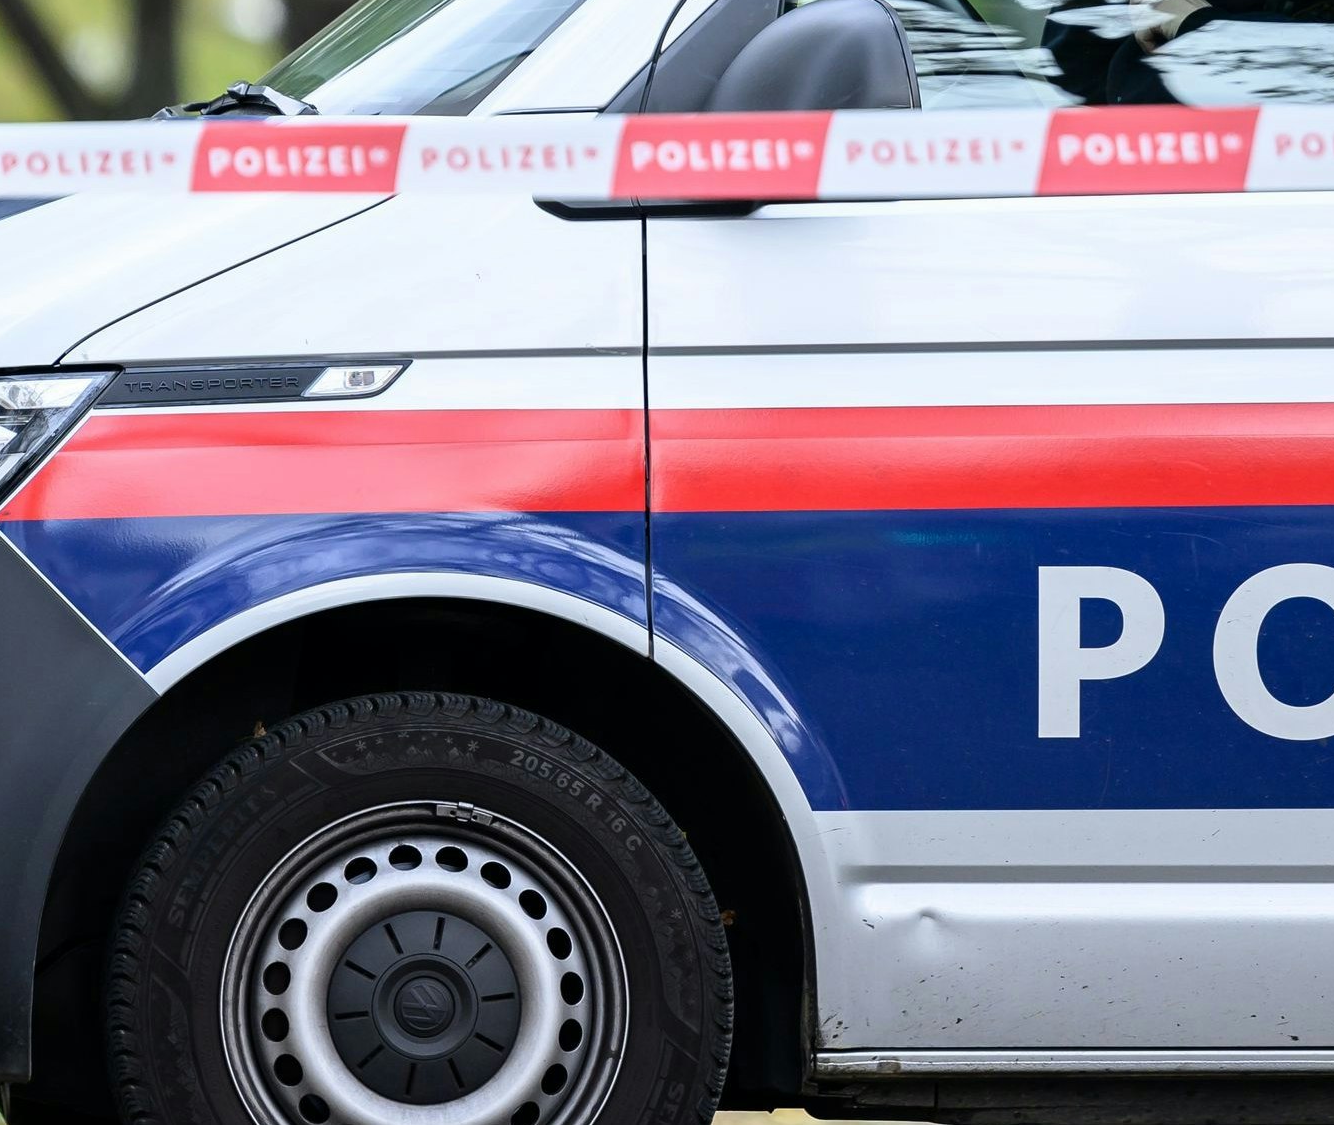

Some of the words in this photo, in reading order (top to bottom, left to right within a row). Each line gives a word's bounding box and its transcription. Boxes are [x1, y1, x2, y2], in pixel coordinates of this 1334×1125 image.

[2, 150, 157, 175] POLIZEI
[209, 146, 363, 177] POLIZEI
[421, 145, 574, 173] POLIZEI
[631, 140, 788, 172] POLIZEI
[846, 138, 1002, 165] POLIZEI
[1058, 133, 1216, 166] POLIZEI
[125, 376, 300, 393] TRANSPORTER
[509, 750, 585, 796] 205/65
[585, 794, 603, 812] R
[605, 810, 627, 833] 16
[625, 834, 642, 851] C
